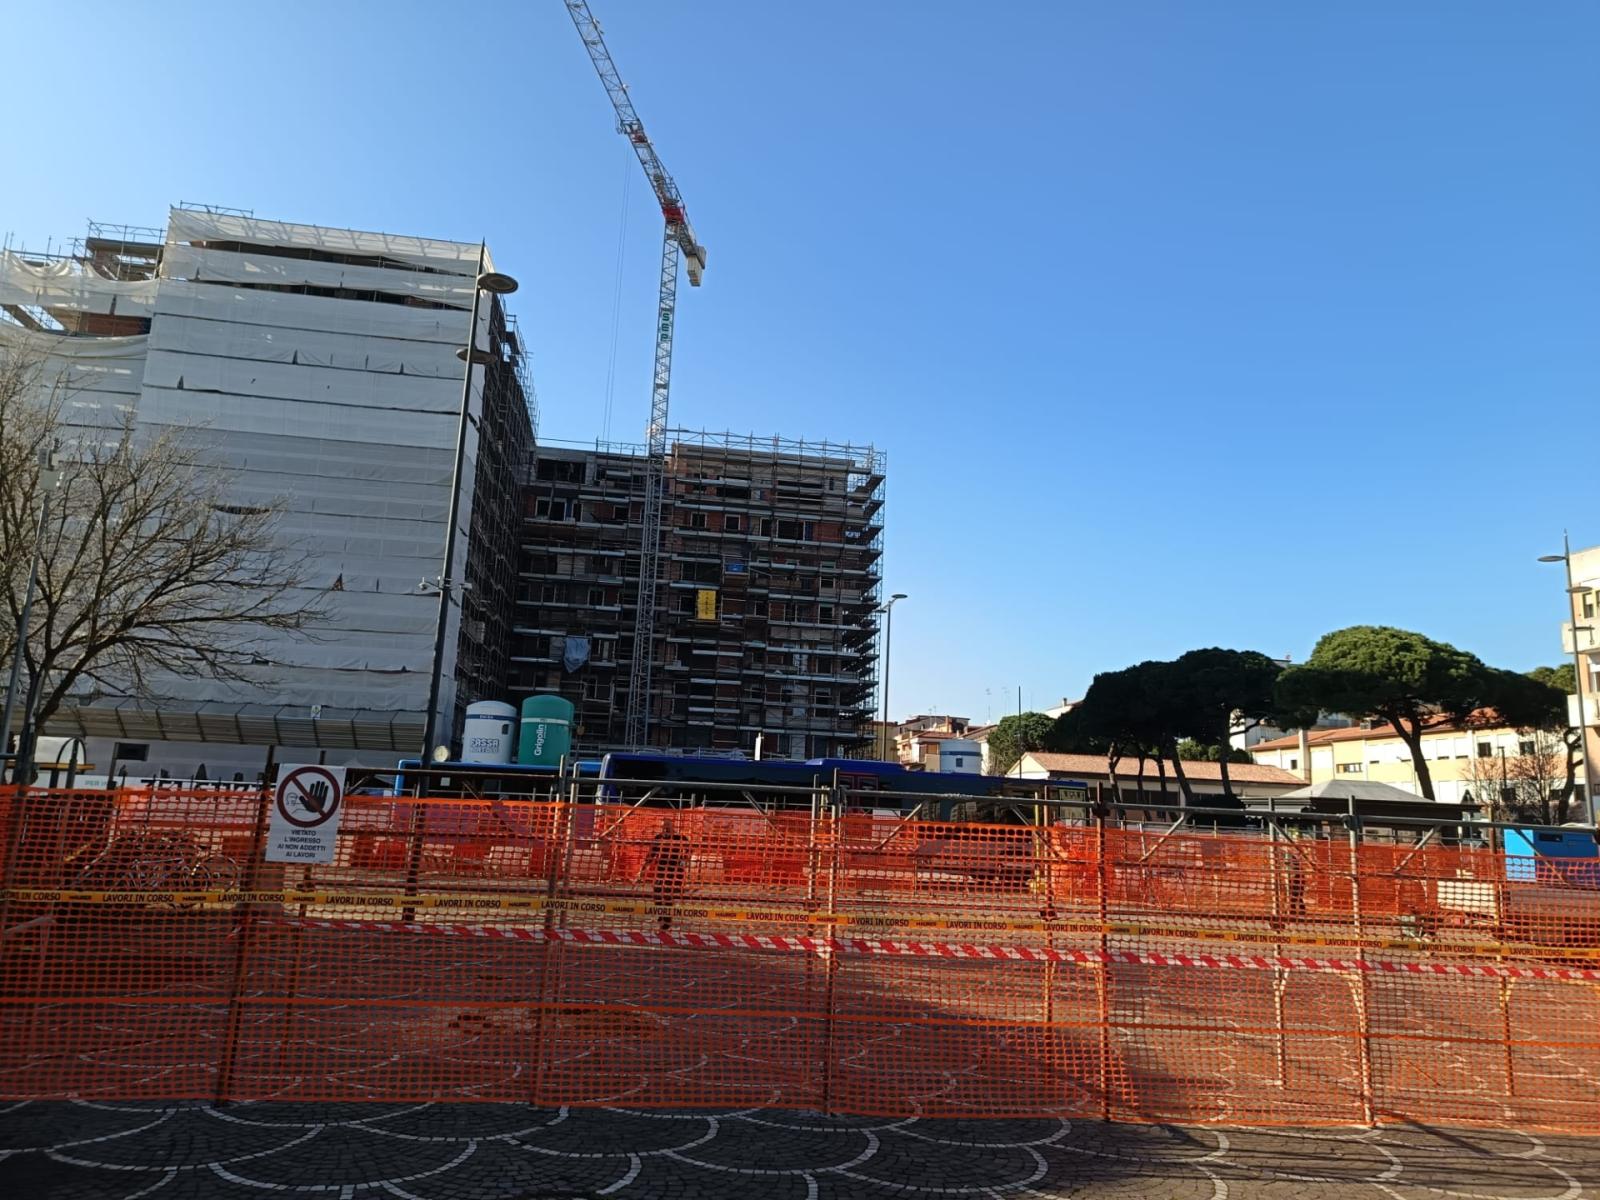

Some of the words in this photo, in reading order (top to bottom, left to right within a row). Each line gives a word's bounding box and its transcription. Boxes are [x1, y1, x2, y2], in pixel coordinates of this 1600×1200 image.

[534, 724, 545, 756] Grigolin
[21, 892, 31, 900] IN
[34, 892, 61, 901] CORSO
[103, 894, 133, 902] LAVORI
[136, 894, 146, 902] IN
[149, 894, 175, 902] CORSO
[218, 893, 248, 902] LAVORI
[248, 893, 257, 901] IN
[326, 896, 355, 904] LAVORI
[357, 896, 366, 904] IN
[368, 897, 394, 905] CORSO
[434, 899, 463, 907] LAVORI
[464, 899, 473, 907] IN
[475, 900, 500, 908] CORSO
[541, 901, 568, 910] LAVORI
[570, 902, 579, 910] IN
[581, 903, 606, 911] CORSO
[645, 907, 672, 915] LAVORI
[673, 908, 682, 916] IN
[684, 909, 708, 917] CORSO
[746, 912, 773, 920] LAVORI
[775, 913, 783, 921] IN
[785, 914, 809, 922] CORSO
[847, 917, 874, 925] LAVORI
[876, 918, 883, 926] IN
[885, 919, 909, 927] CORSO
[946, 921, 972, 929] LAVORI
[974, 922, 982, 930] IN
[984, 922, 1007, 930] CORSO
[1043, 924, 1068, 932] LAVORI
[1079, 925, 1102, 933] CORSO
[1139, 928, 1164, 936] LAVORI
[1165, 929, 1173, 937] IN
[1175, 930, 1198, 938] CORSO
[1234, 934, 1257, 942] LAVORI
[1325, 938, 1349, 946] LAVORI
